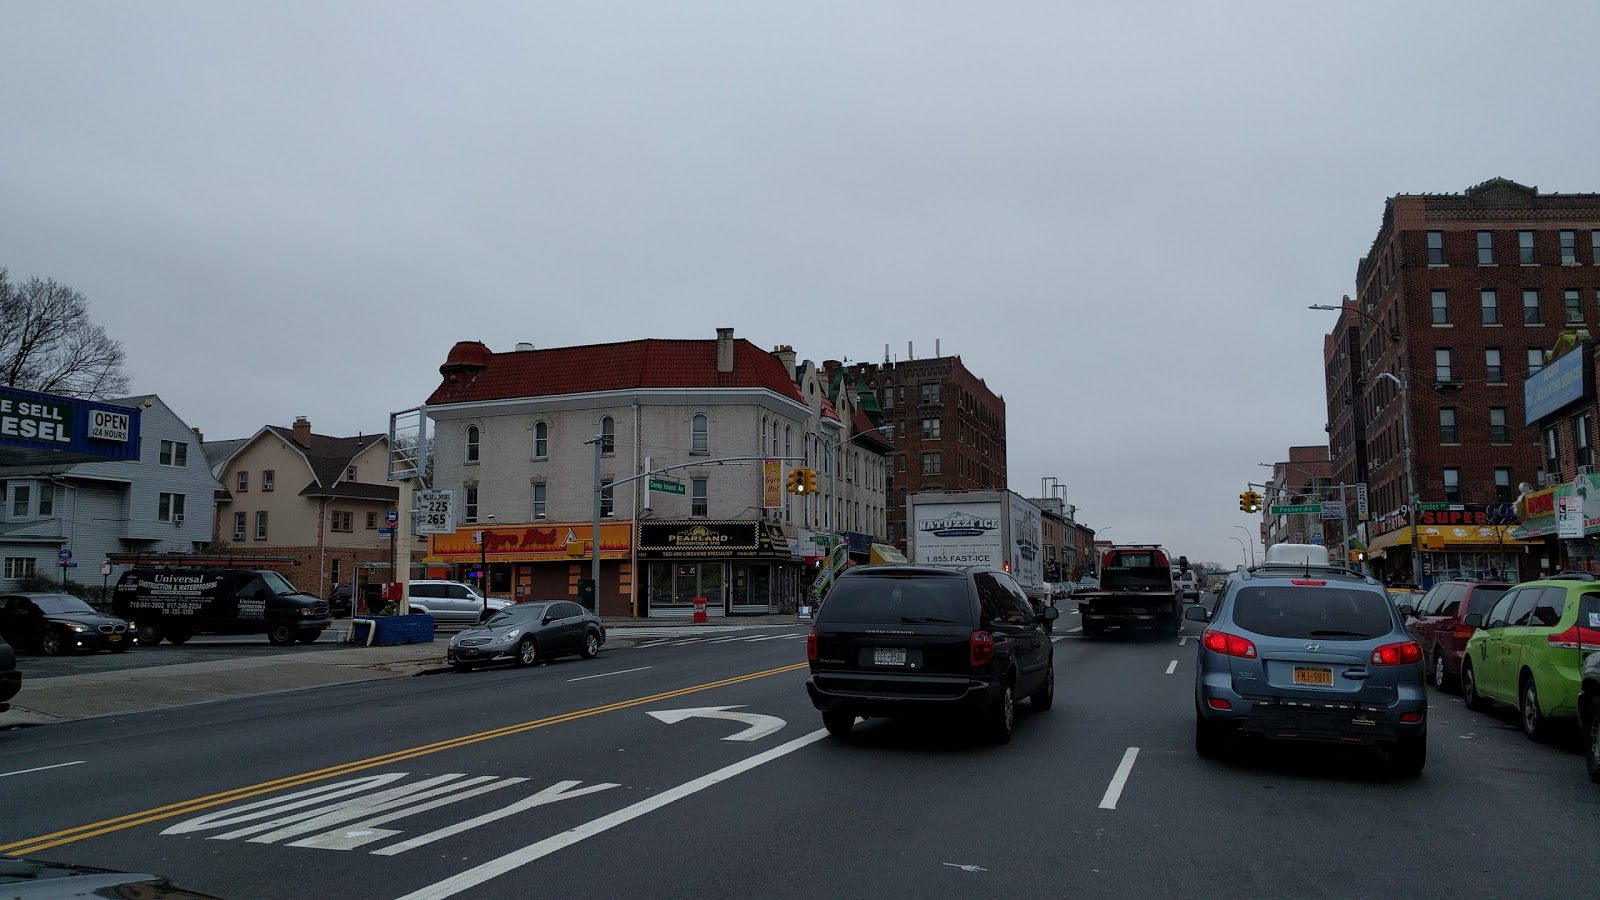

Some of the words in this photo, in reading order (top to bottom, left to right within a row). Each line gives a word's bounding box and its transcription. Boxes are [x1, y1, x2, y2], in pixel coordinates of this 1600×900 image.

[18, 402, 63, 420] SELL
[95, 412, 127, 430] OPEN
[104, 430, 127, 439] HOURS
[765, 474, 781, 485] Gyro
[650, 480, 663, 490] Coney
[663, 482, 677, 491] Island
[429, 501, 448, 512] 225
[427, 514, 446, 524] 265
[1423, 511, 1487, 525] SUPER
[919, 519, 977, 531] NATUZZI
[979, 519, 999, 530] ICE
[483, 530, 519, 550] Gyro
[668, 534, 728, 542] PEARLAND
[926, 554, 991, 562] 1.855.FAST-ICE
[154, 574, 204, 583] Universal
[138, 579, 172, 591] CONSTRUCTION
[173, 583, 178, 591] &
[178, 581, 218, 591] WATERPROOFING
[1297, 671, 1331, 682] FMJ-9811
[159, 772, 622, 856] ONLY
